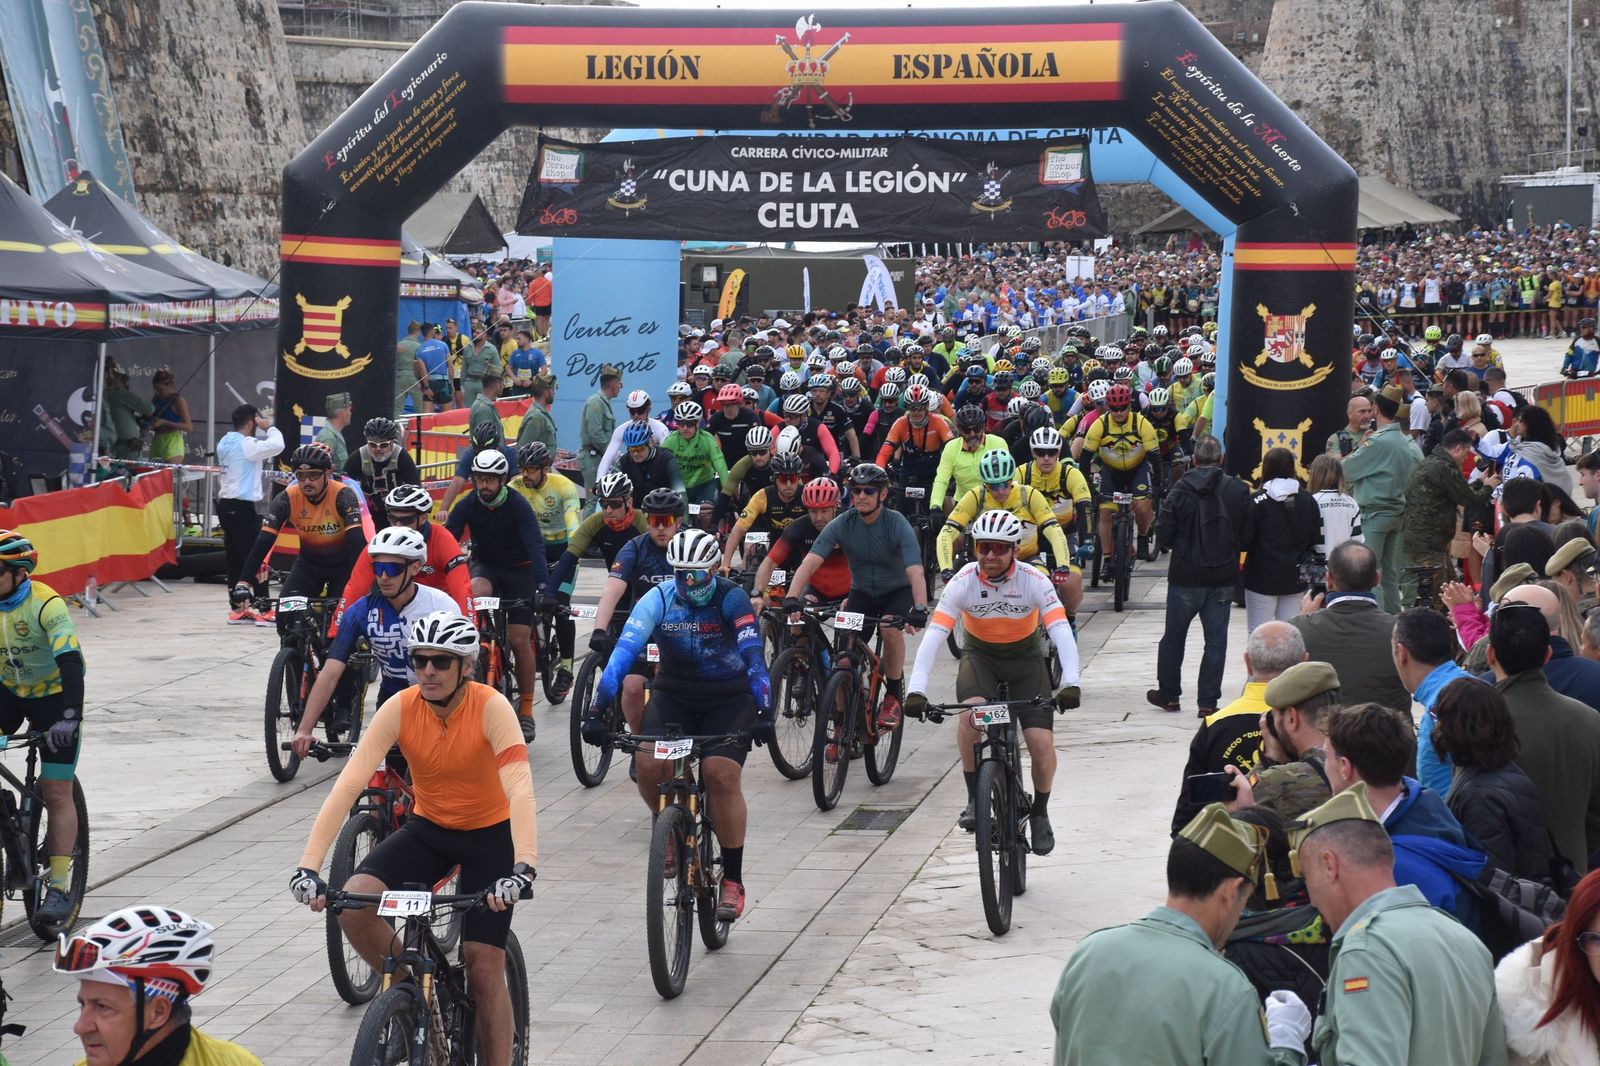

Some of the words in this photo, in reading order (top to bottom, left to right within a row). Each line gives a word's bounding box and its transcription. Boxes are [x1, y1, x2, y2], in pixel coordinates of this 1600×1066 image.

[586, 49, 701, 80] LEGIÓN
[893, 46, 1060, 80] ESPAÑOLA
[322, 124, 372, 170] Espíritu
[373, 100, 390, 125] del
[387, 51, 448, 110] Legionario
[1175, 49, 1228, 103] Espíritu
[1226, 101, 1244, 115] de
[1239, 113, 1256, 127] la
[1253, 121, 1302, 172] Muerte
[731, 147, 788, 158] CARRERA
[793, 144, 889, 160] CÍVICO-MILITAR
[760, 171, 793, 193] DE
[803, 171, 836, 193] LA
[757, 202, 860, 229] CEUTA
[637, 320, 660, 336] es
[566, 351, 661, 388] Deporte
[846, 617, 861, 626] 362
[989, 709, 1006, 719] 162
[1222, 737, 1243, 759] TERCIO
[406, 900, 419, 911] 11
